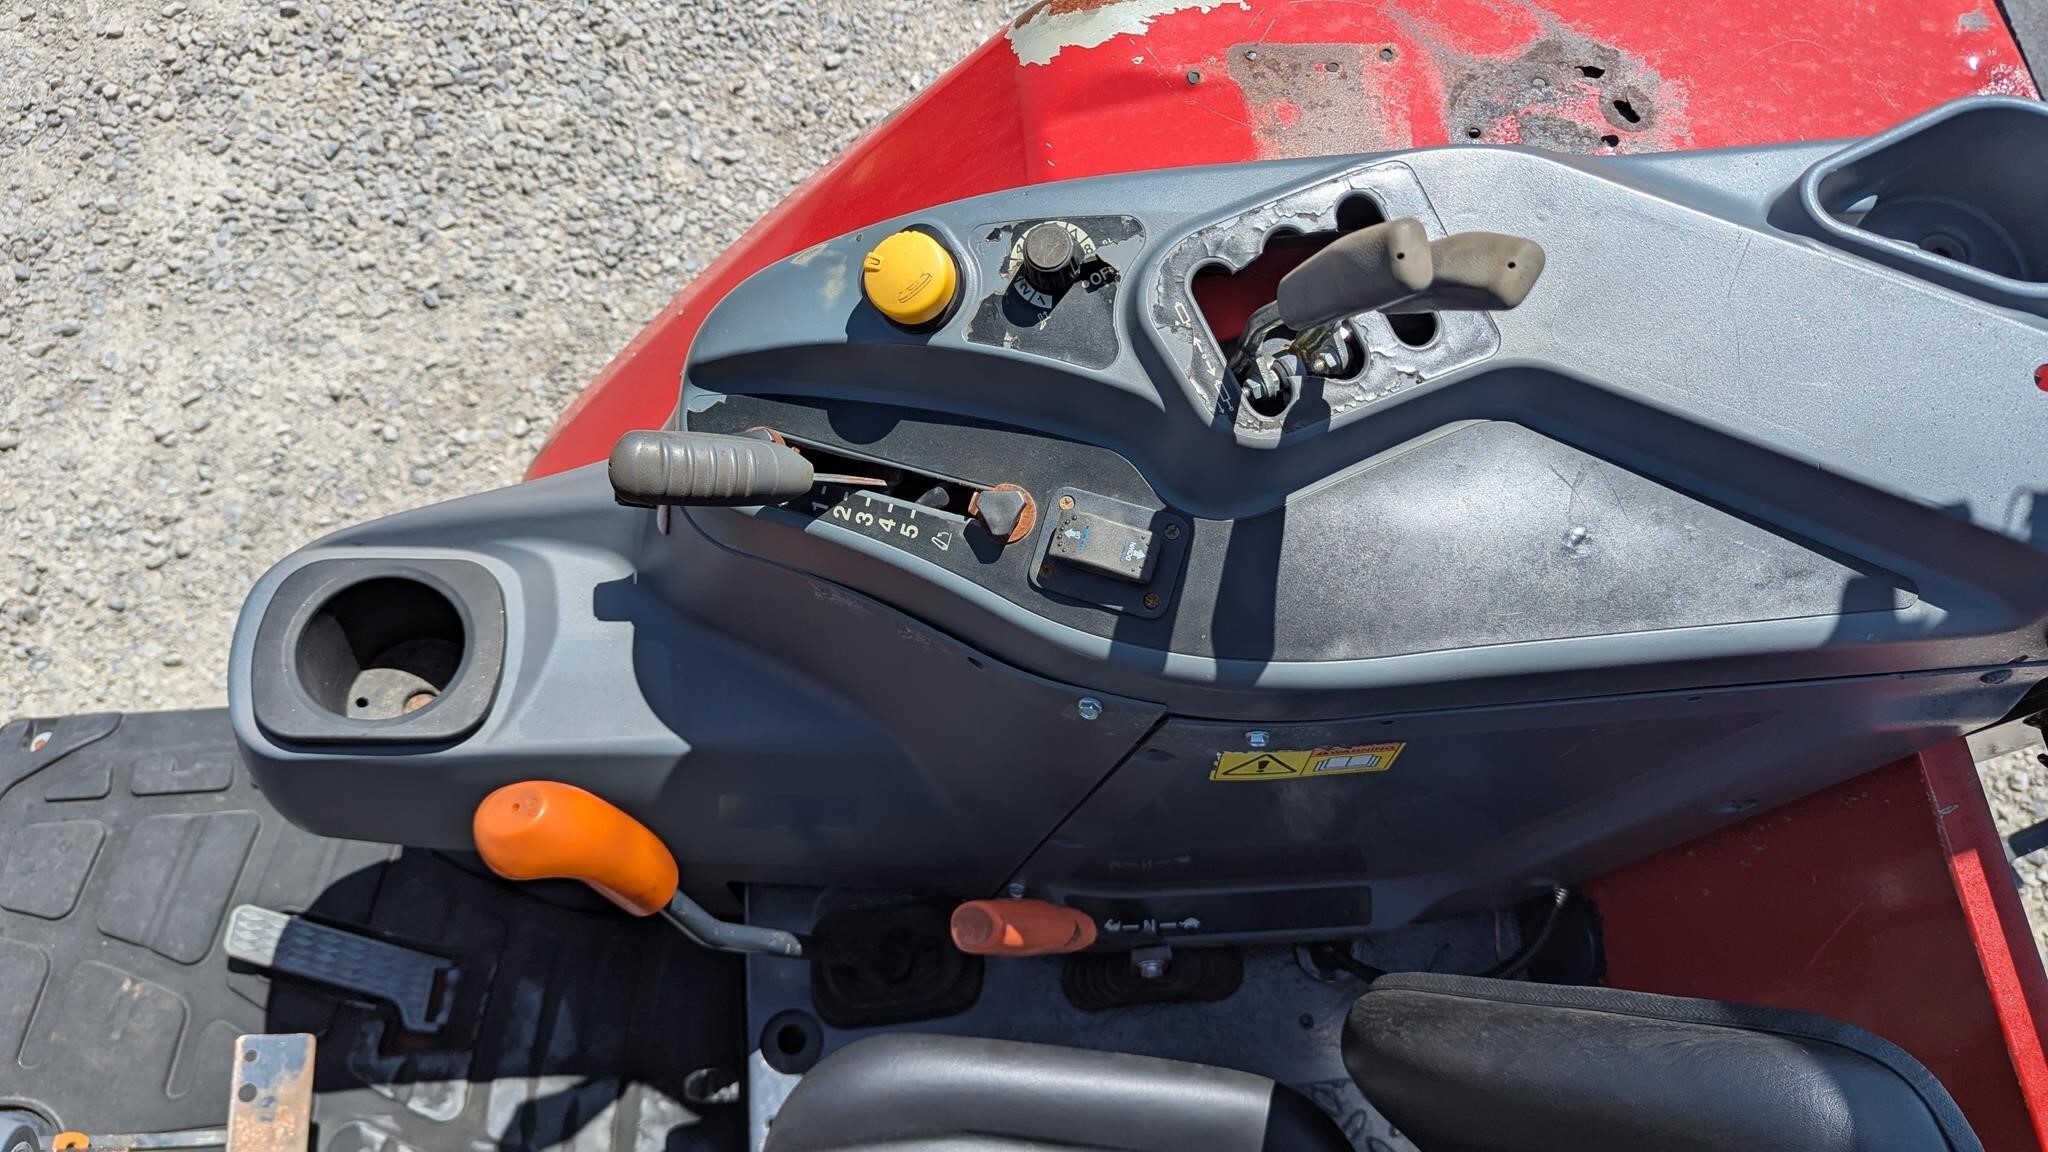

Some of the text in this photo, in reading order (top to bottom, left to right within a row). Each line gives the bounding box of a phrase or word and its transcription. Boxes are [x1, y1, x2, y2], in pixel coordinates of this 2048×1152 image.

[1016, 243, 1024, 255] 4
[1083, 243, 1093, 255] 8
[1019, 284, 1031, 295] 2
[1037, 296, 1046, 306] 1
[812, 501, 829, 511] 1
[833, 505, 851, 521] 2
[855, 511, 874, 526] 3
[878, 517, 896, 532] 4
[900, 523, 919, 539] 5
[1144, 919, 1155, 931] N
